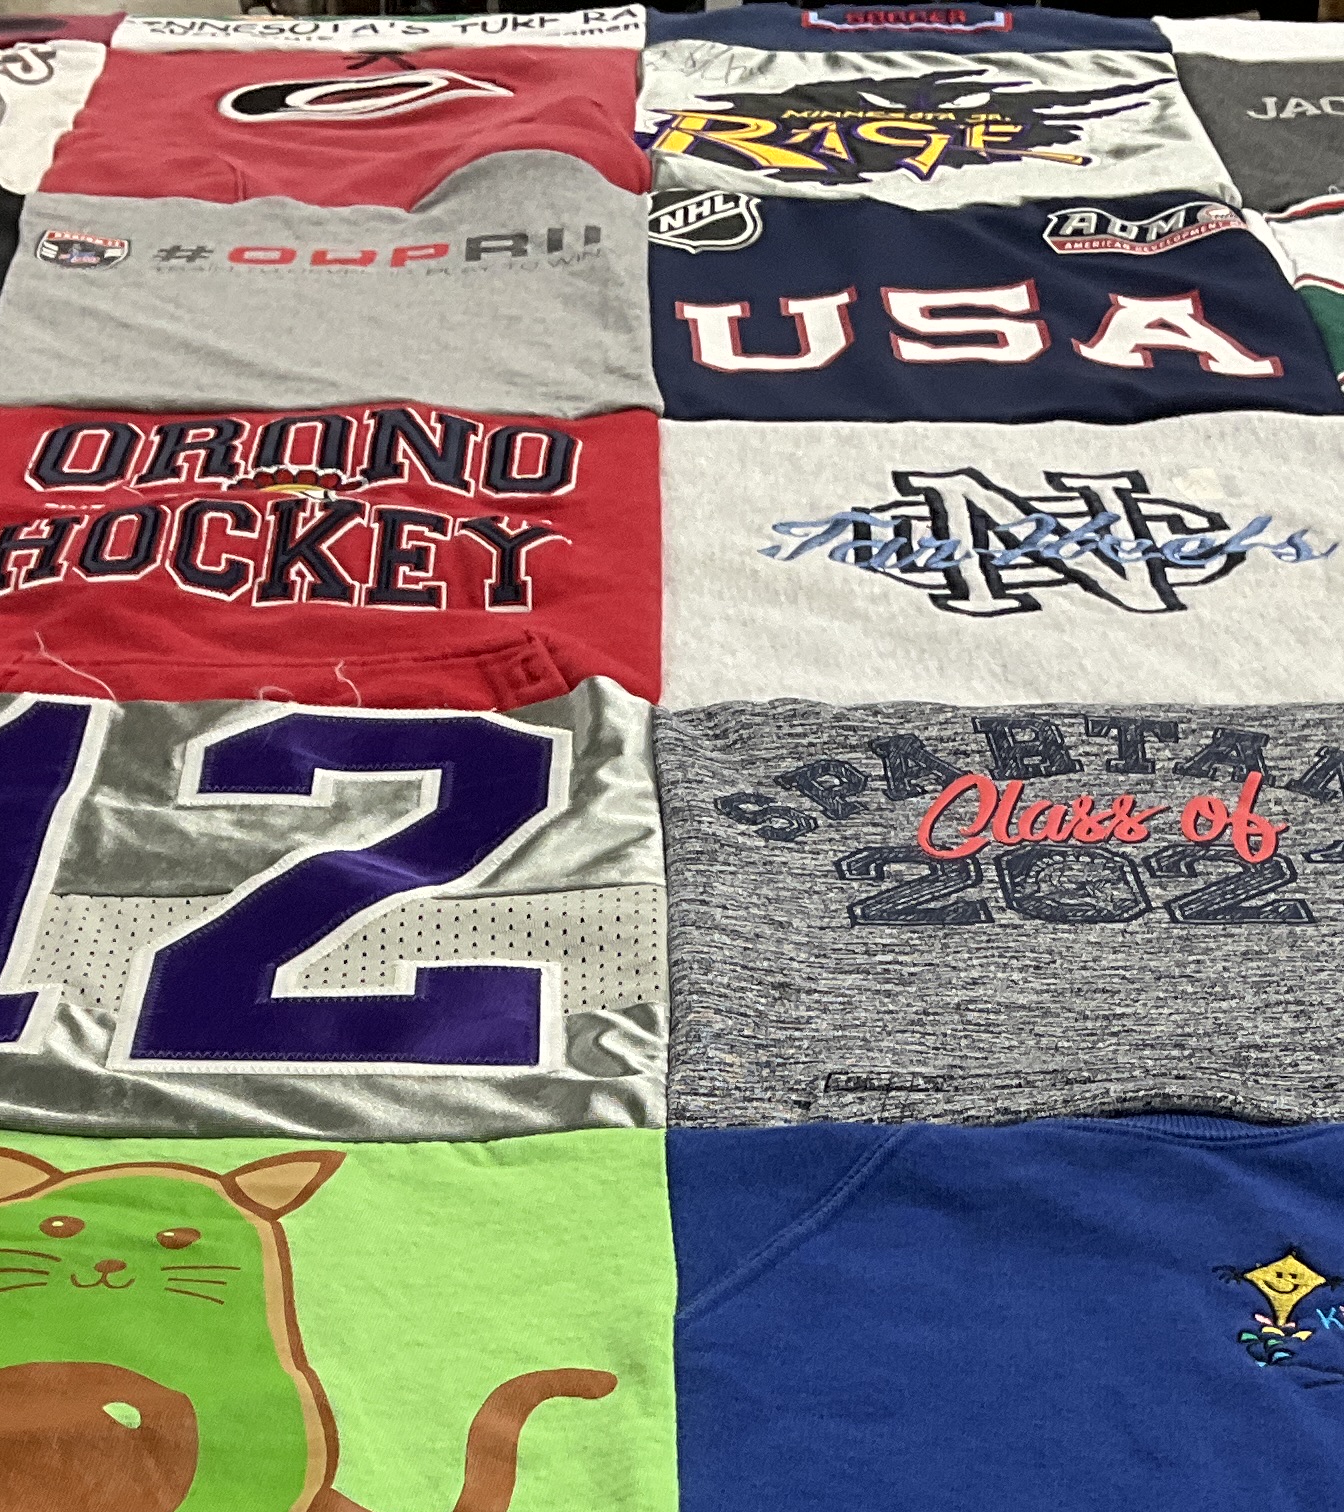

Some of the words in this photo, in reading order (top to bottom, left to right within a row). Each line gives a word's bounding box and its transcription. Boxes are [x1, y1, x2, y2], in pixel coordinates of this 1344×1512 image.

[646, 108, 1093, 182] RAGE
[780, 109, 957, 121] MINNESOTA
[659, 193, 742, 232] NHL
[1059, 209, 1187, 242] ADM
[1063, 240, 1132, 252] AMERICAN
[674, 278, 1285, 378] USA
[24, 406, 583, 496] ORONO
[757, 510, 976, 571] Tar
[976, 510, 1339, 569] Heels
[917, 774, 1174, 861] Class
[1181, 771, 1290, 864] of
